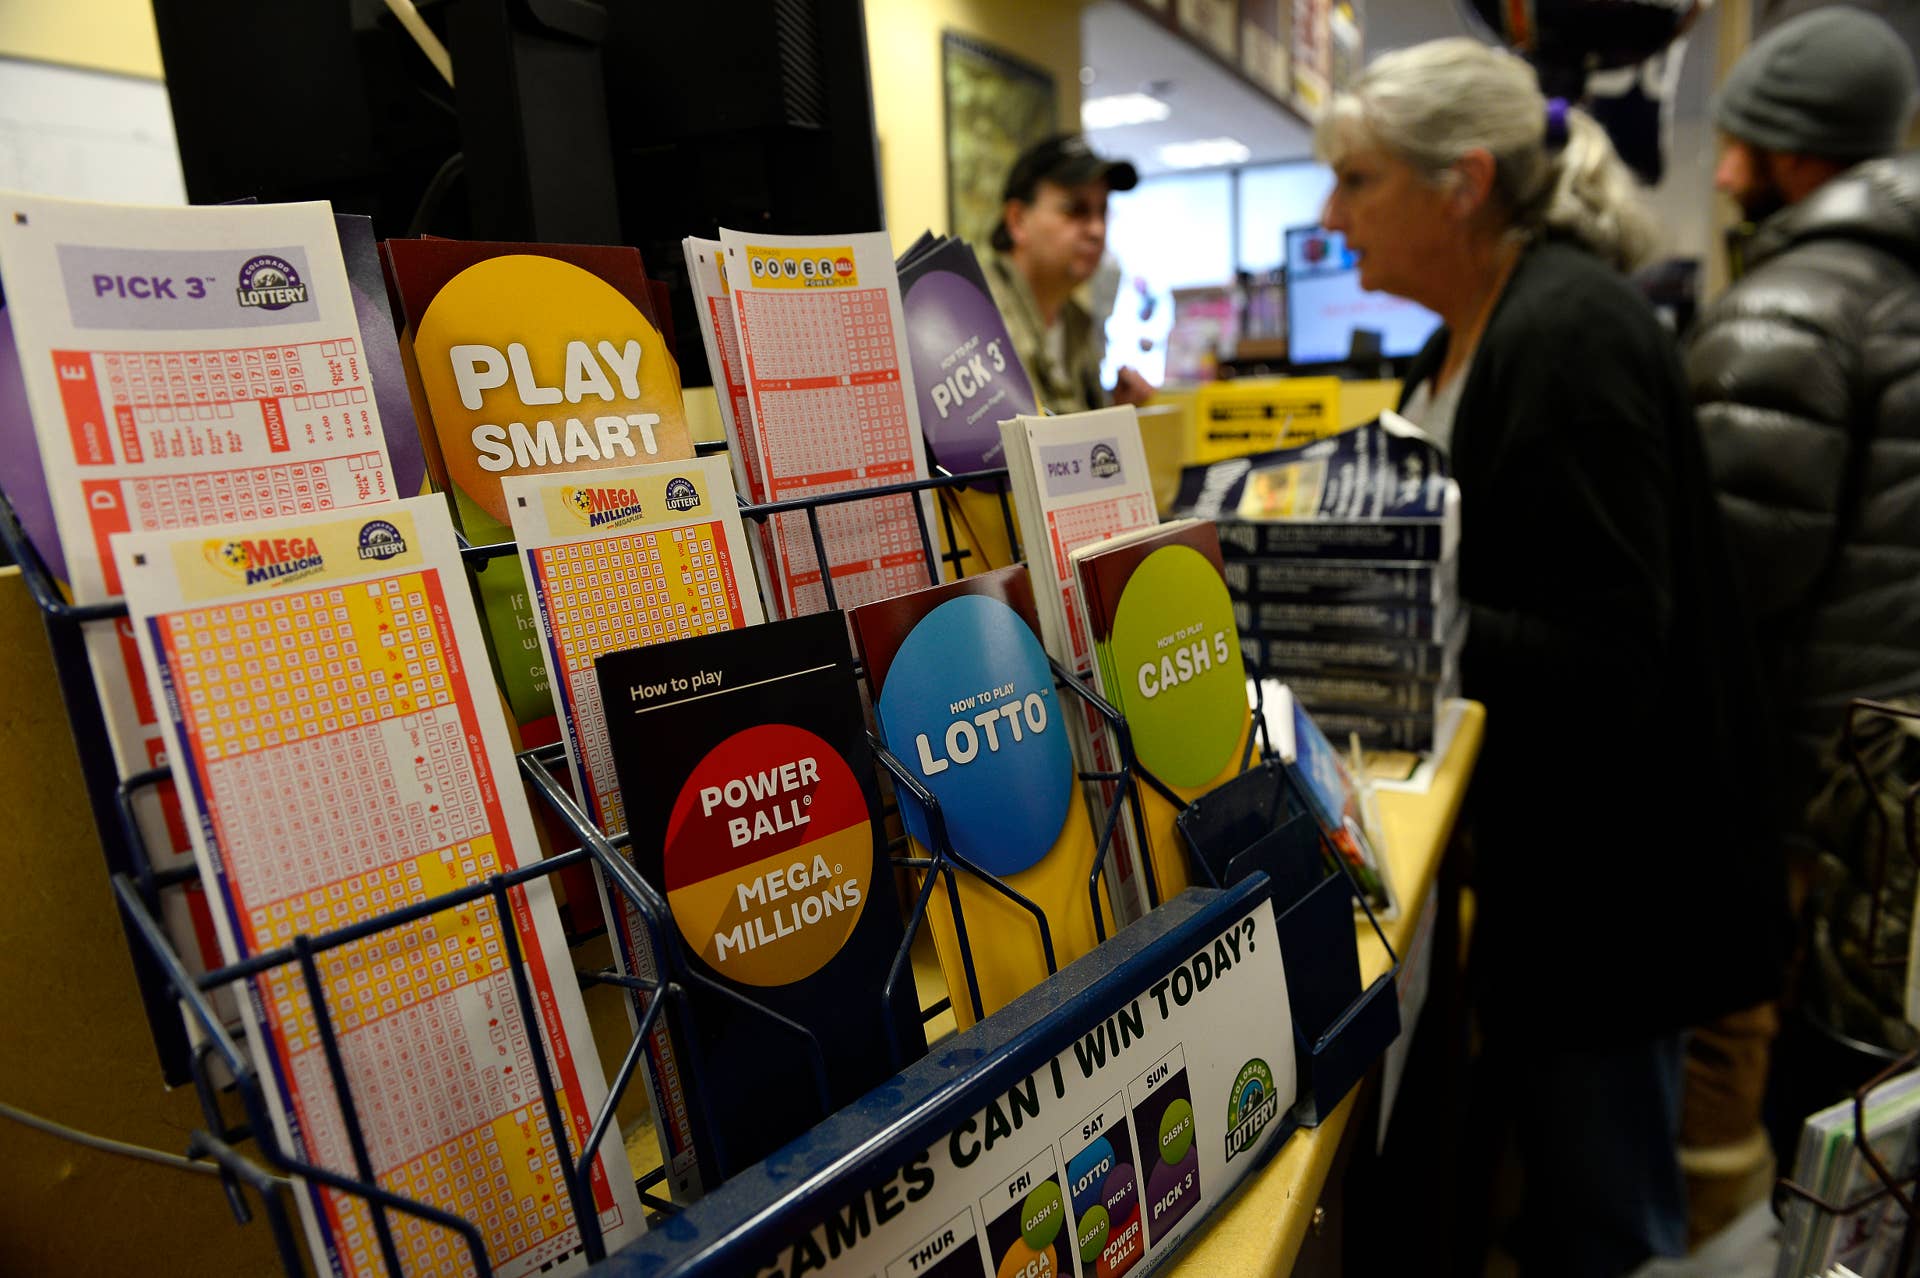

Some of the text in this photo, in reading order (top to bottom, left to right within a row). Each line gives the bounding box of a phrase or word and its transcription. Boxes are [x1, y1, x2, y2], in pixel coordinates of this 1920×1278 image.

[245, 258, 290, 276] COLORADO
[752, 258, 834, 277] POWER
[92, 274, 178, 300] PICK
[239, 286, 306, 307] LOTTERY
[226, 355, 238, 363] 6
[246, 354, 259, 362] 7
[285, 351, 304, 391] 9 9 9
[335, 361, 345, 383] Pick
[349, 357, 360, 382] VOID
[60, 365, 87, 381] E
[250, 371, 263, 379] 7
[266, 352, 285, 394] 8 8 8
[327, 359, 340, 386] Quick
[449, 338, 642, 412] PLAY
[930, 353, 992, 419] PICK
[986, 341, 1006, 373] 3
[264, 401, 286, 447] AMOUNT
[321, 415, 334, 442] $1.00
[343, 412, 355, 439] $2.00
[360, 410, 372, 437] $5.00
[471, 413, 660, 473] SMART
[1071, 459, 1080, 474] 3
[354, 472, 366, 500] Quick
[360, 475, 371, 497] Pick
[375, 470, 387, 496] VOID
[668, 480, 691, 490] COLORADO
[90, 490, 118, 510] D
[585, 488, 640, 514] MEGA
[666, 497, 700, 510] LOTTERY
[590, 504, 642, 527] MILLIONS
[240, 537, 320, 569] MEGA
[358, 541, 406, 560] LOTTERY
[245, 554, 324, 585] MILLIONS
[510, 593, 523, 611] If
[541, 609, 553, 639] BOARD
[1157, 622, 1204, 649] HOW TO PLAY
[1138, 638, 1211, 698] CASH
[1214, 631, 1229, 664] 5
[629, 669, 724, 702] How to play
[950, 682, 1015, 715] HOW TO PLAY
[571, 736, 582, 765] BOARD
[699, 756, 821, 818] POWER
[713, 878, 863, 963] MILLIONS
[1146, 1062, 1169, 1089] SUN
[1232, 1064, 1266, 1104] COLORADO
[757, 916, 1256, 1278] AMES CAN I WIN TODAY?
[1082, 1113, 1104, 1140] SAT
[1162, 1116, 1190, 1147] CASH 5
[1226, 1095, 1276, 1159] LOTTERY
[1008, 1170, 1031, 1199] FRI
[1107, 1180, 1133, 1210] PICK 3
[1153, 1173, 1193, 1220] PICK 3
[1025, 1199, 1059, 1232] CASH 5
[1079, 1220, 1106, 1248] CASH 5
[1103, 1221, 1139, 1262] POWER
[908, 1229, 955, 1271] THUR
[1109, 1242, 1136, 1271] BALL
